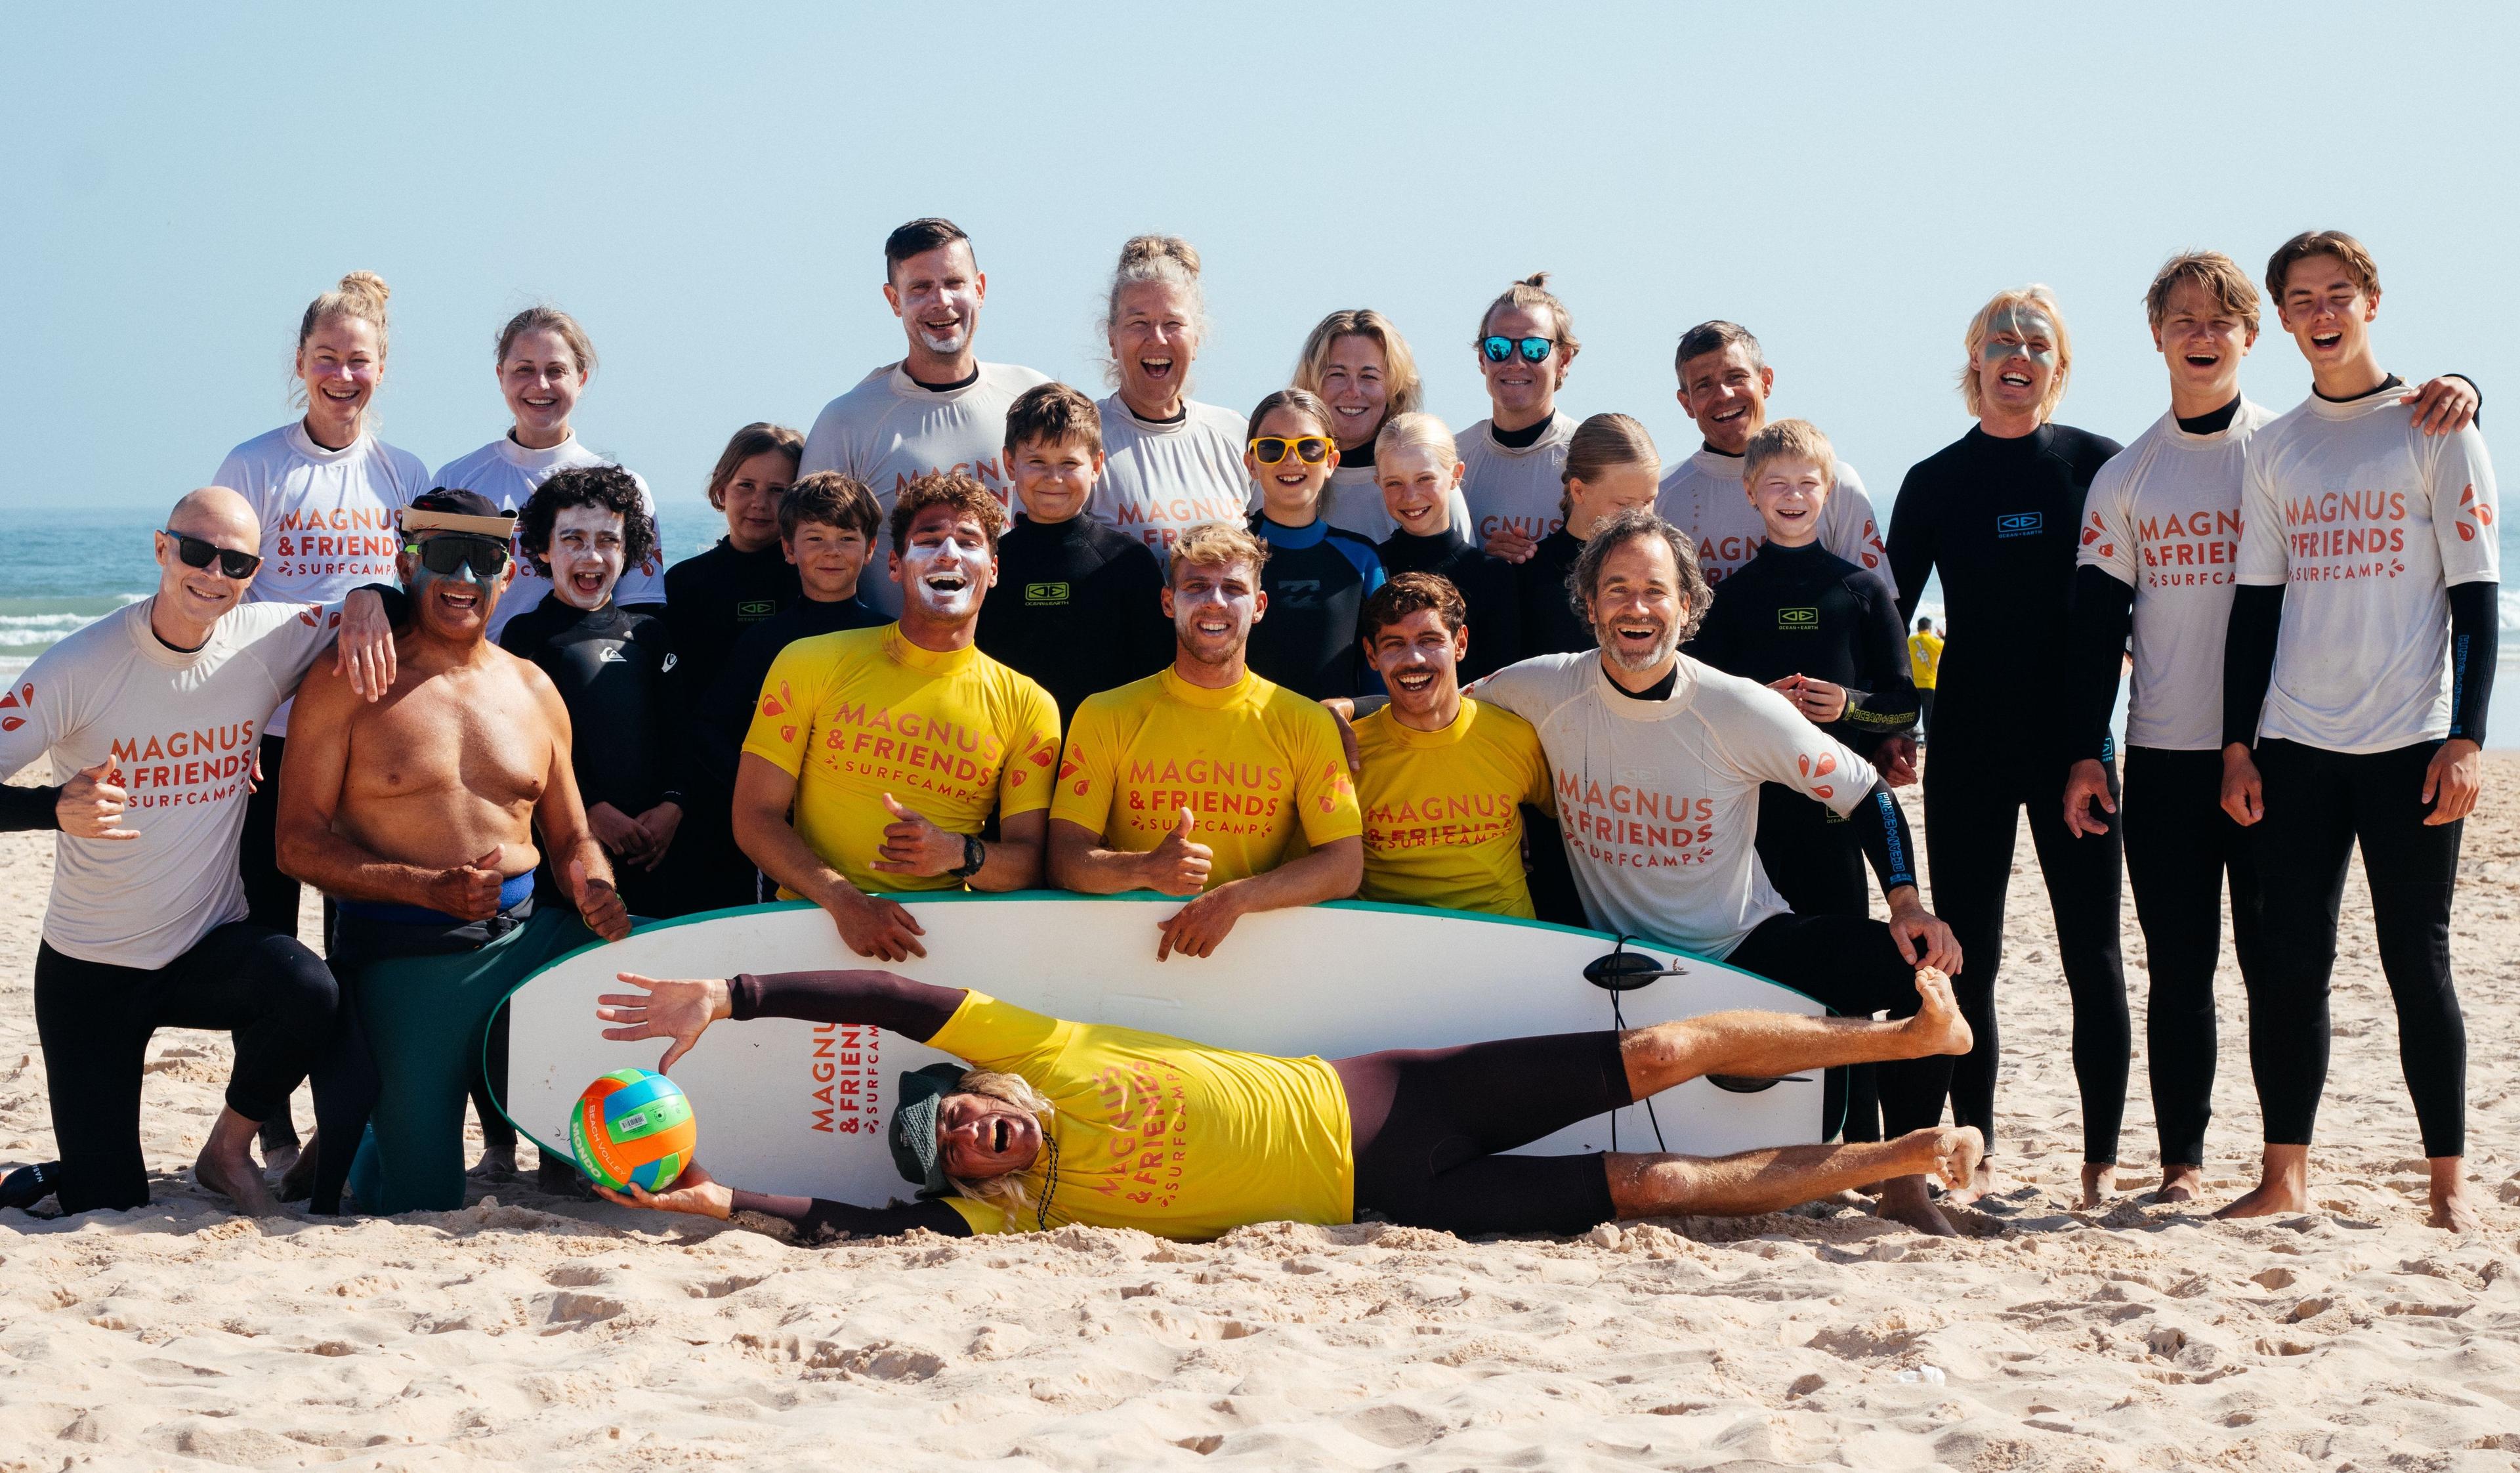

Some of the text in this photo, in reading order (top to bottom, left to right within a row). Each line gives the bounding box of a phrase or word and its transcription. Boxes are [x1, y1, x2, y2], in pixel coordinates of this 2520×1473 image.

[279, 508, 402, 532] MAGNUS
[1118, 497, 1244, 525] MAGNUS
[2139, 509, 2239, 542] MAGN
[2285, 490, 2405, 526] MAGNUS
[1480, 515, 1564, 541] GNUS
[2298, 528, 2404, 558] FRIENDS
[278, 536, 401, 557] & FRIENDS
[1699, 536, 1767, 561] AGN
[299, 563, 390, 574] SURFCAMP
[2162, 571, 2235, 586] SURFCA
[2296, 563, 2384, 582] SURFCAMP
[111, 720, 253, 763] MAGNUS
[833, 702, 998, 761] MAGNUS
[134, 750, 251, 788] FRIENDS
[826, 729, 993, 787] & FRIENDS
[1129, 758, 1282, 791] MAGNUS
[129, 784, 236, 808] SURFCAMP
[845, 761, 966, 799] SURFCAMP
[1559, 768, 1713, 822] MAGNUS
[1129, 790, 1279, 817] & FRIENDS
[1368, 794, 1512, 824] MAGNUS
[1150, 818, 1258, 835] SUFCAMP
[1579, 810, 1713, 847] FRIENDS
[811, 1023, 836, 1133] MAGNU
[839, 1024, 861, 1134] & FRIEN
[866, 1025, 879, 1114] SURFCAM
[589, 1105, 627, 1176] BEACH VOLLEY
[1091, 1066, 1137, 1197] MAGNUS
[1125, 1060, 1166, 1185] FRIENDS
[1166, 1073, 1186, 1191] SURFCAMP
[573, 1122, 602, 1179] MONDO
